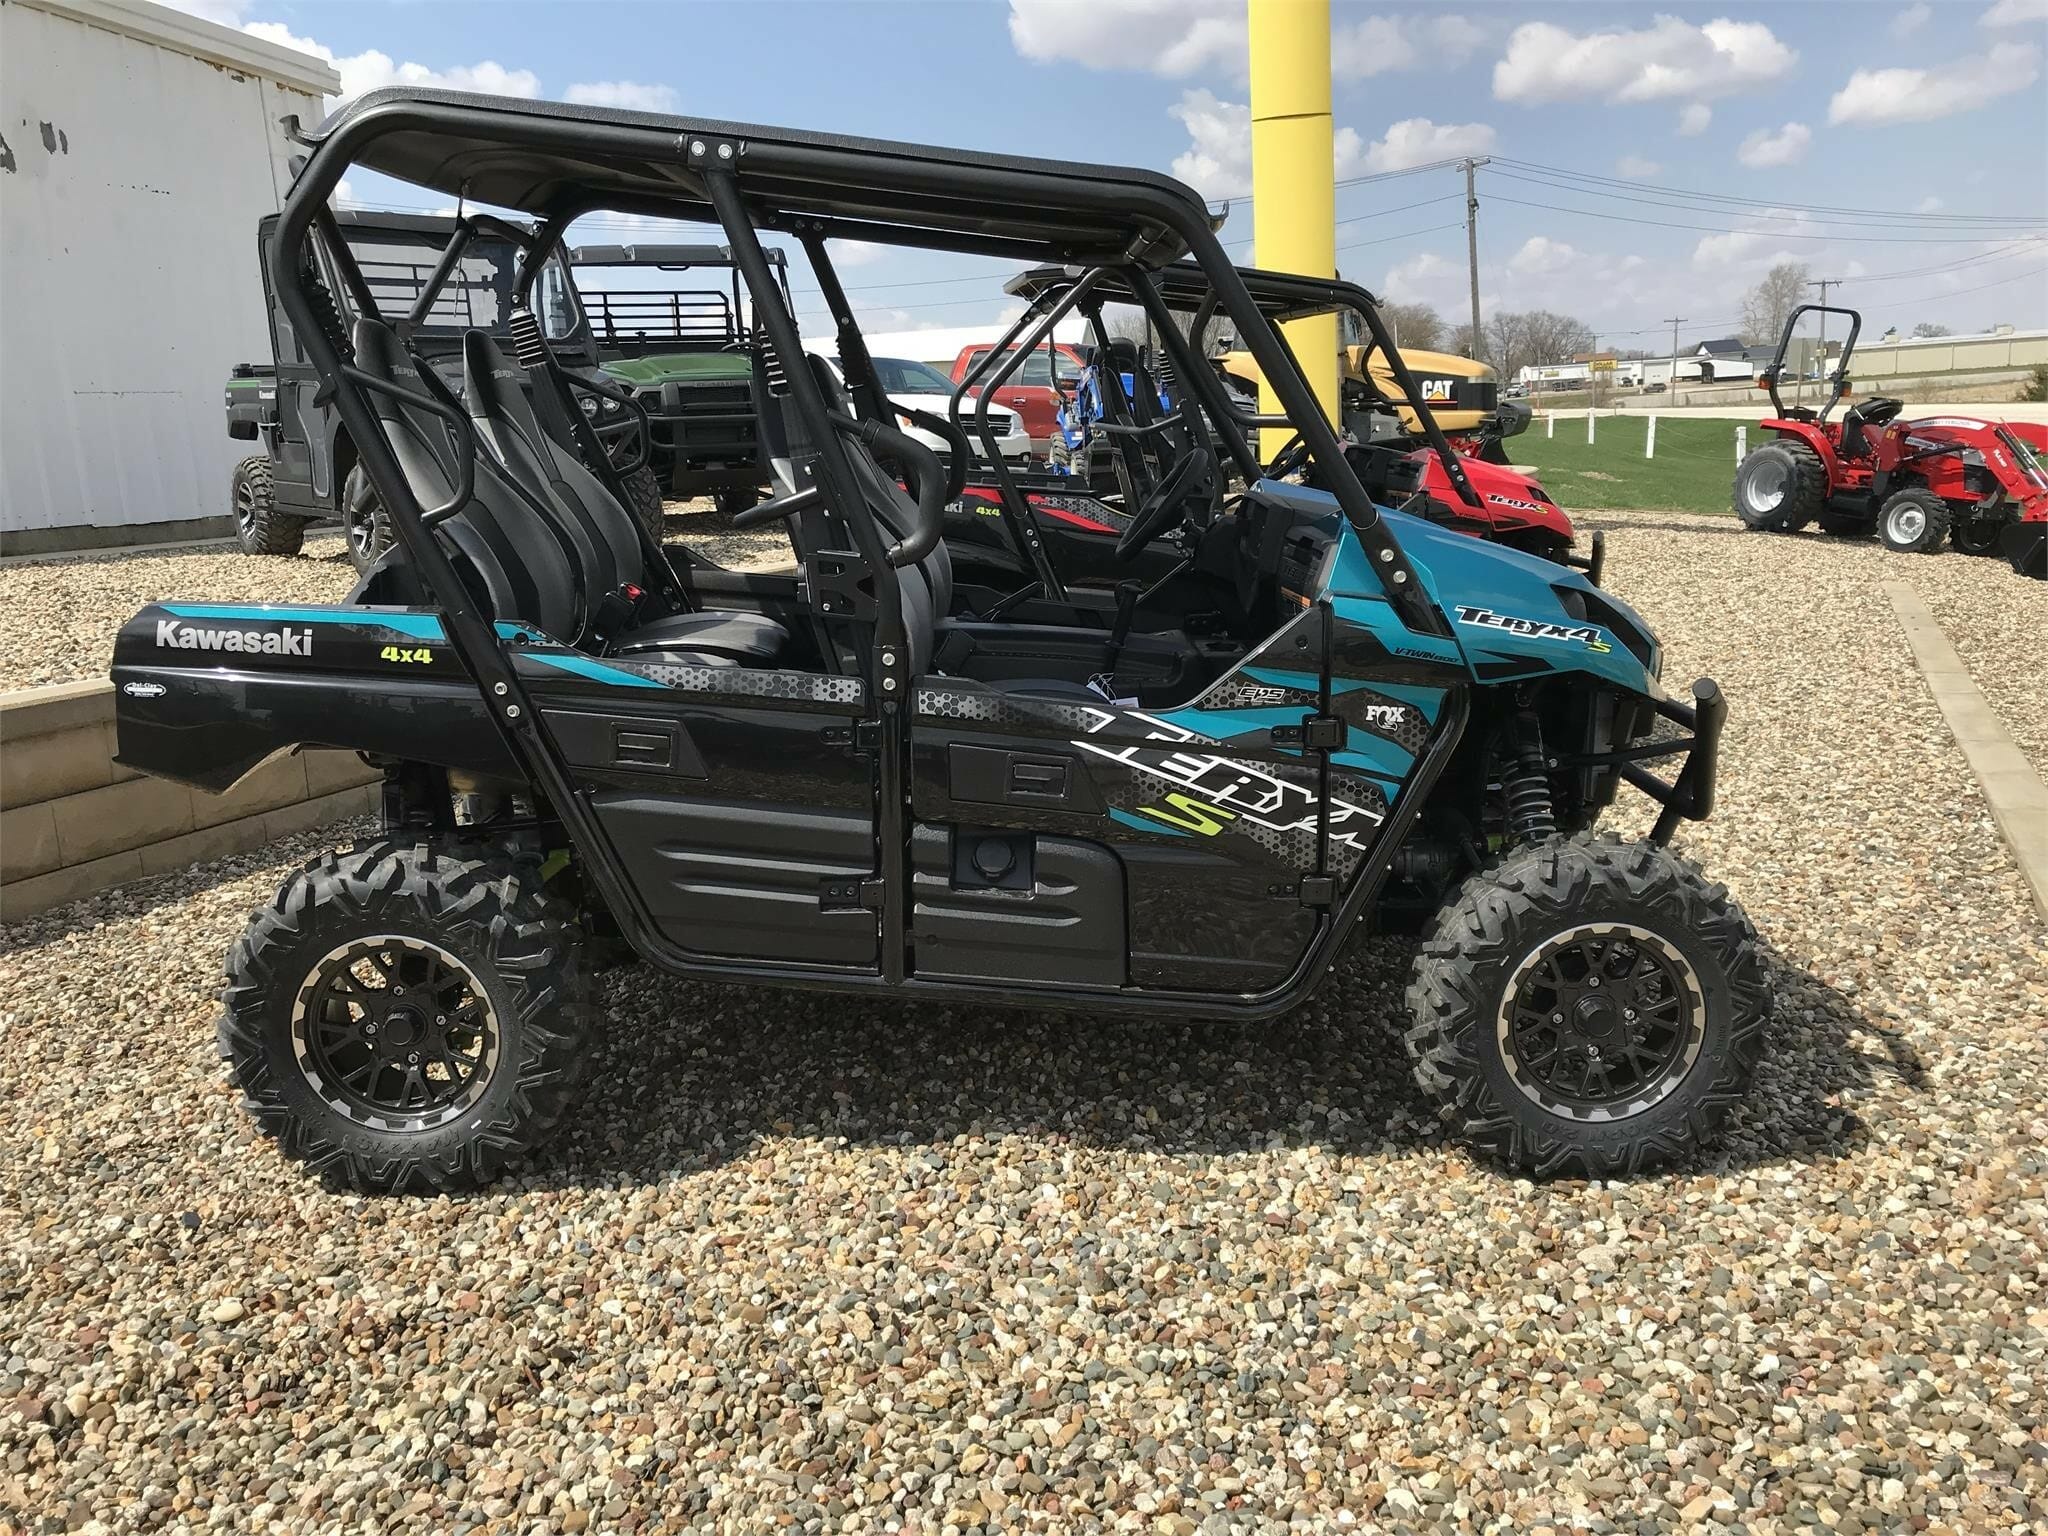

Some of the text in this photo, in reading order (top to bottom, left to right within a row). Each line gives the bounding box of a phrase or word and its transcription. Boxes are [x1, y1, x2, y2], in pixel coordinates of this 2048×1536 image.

[1422, 380, 1453, 400] CAT
[976, 506, 1000, 517] 4x4
[1455, 605, 1601, 644] TERYX4
[156, 620, 313, 657] Kawasaki
[380, 646, 433, 665] 4x4
[1394, 647, 1435, 660] V-TWIN
[1238, 687, 1287, 700] EPS
[1366, 705, 1405, 731] FOX
[1136, 792, 1238, 837] S
